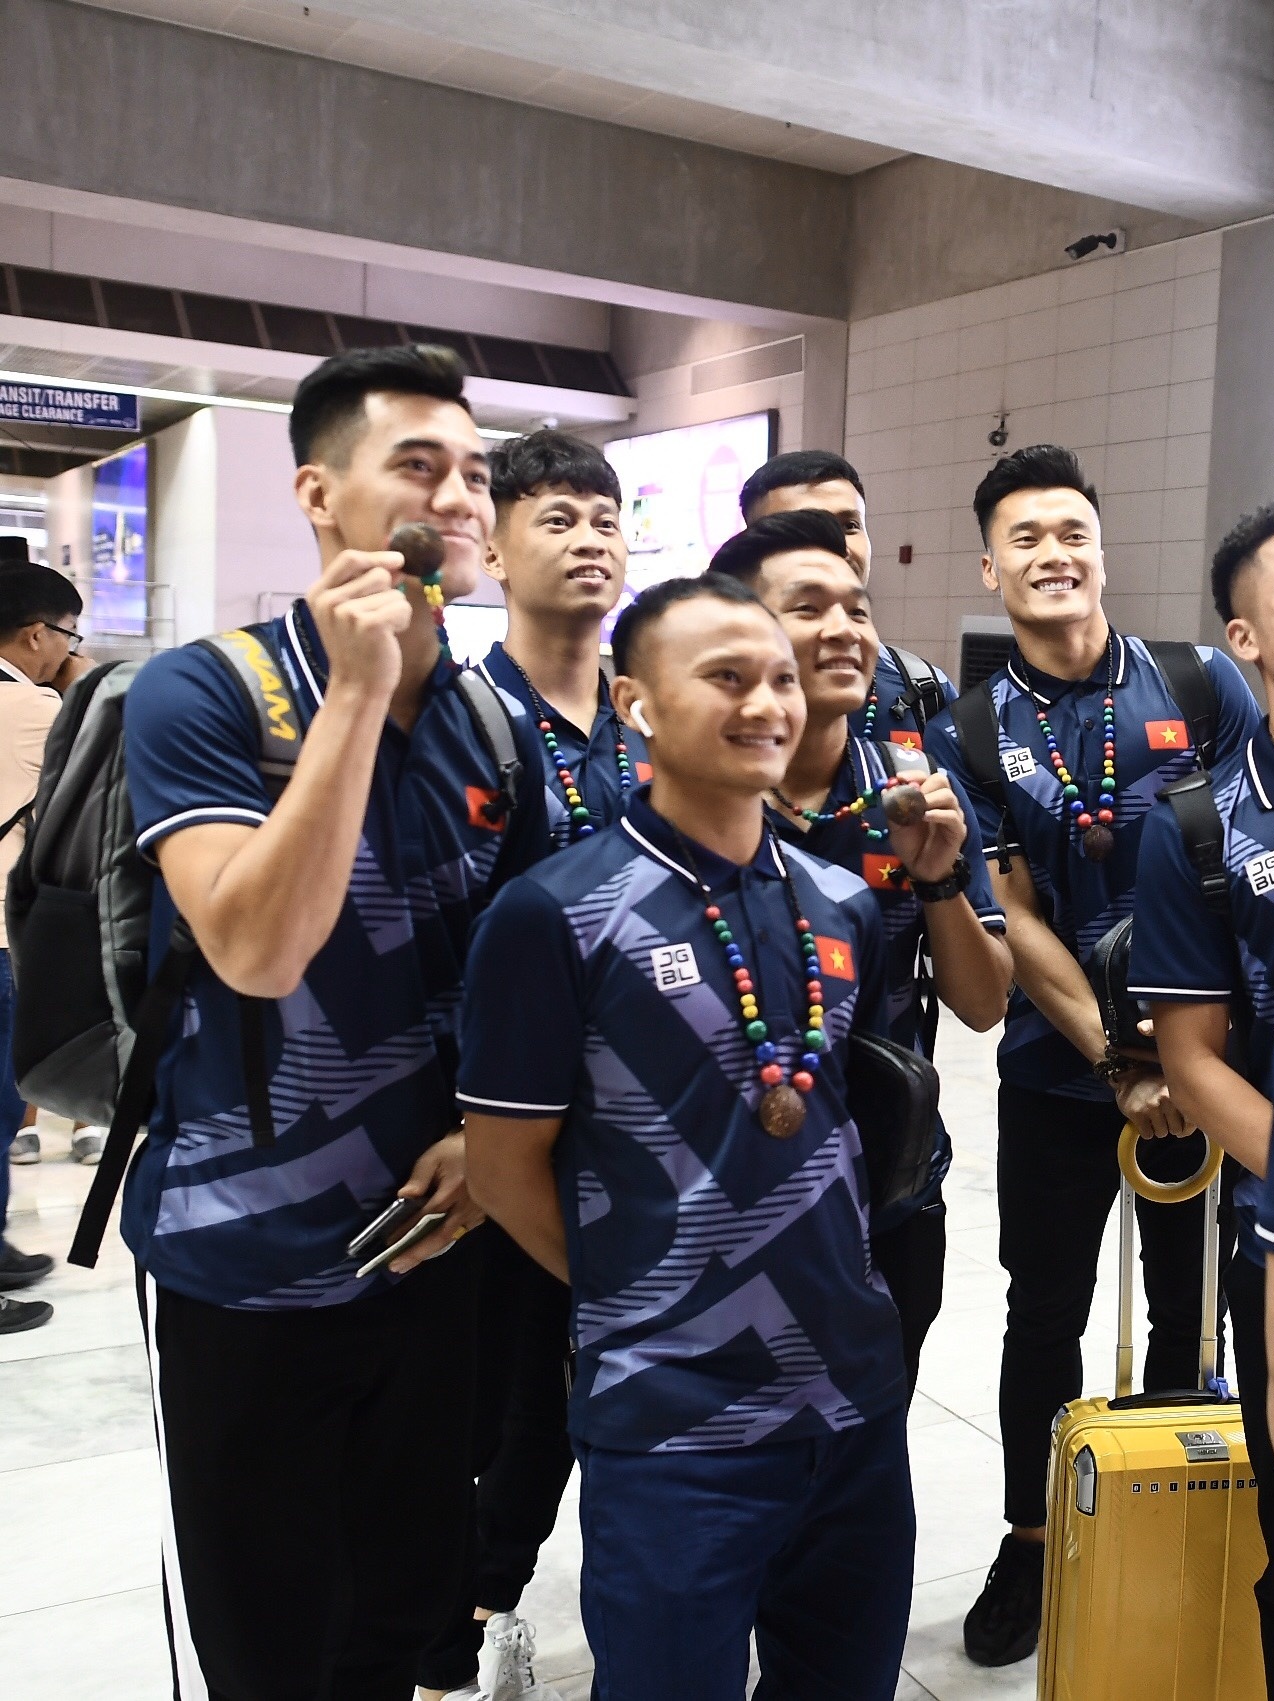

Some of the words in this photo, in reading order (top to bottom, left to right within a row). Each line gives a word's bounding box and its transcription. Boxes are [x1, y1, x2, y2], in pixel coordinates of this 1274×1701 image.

[22, 404, 84, 423] CLEARANCE
[1008, 750, 1029, 767] JG
[1009, 764, 1033, 778] BL
[659, 948, 689, 968] JG
[661, 967, 694, 985] BL
[1188, 1480, 1230, 1490] TIEN
